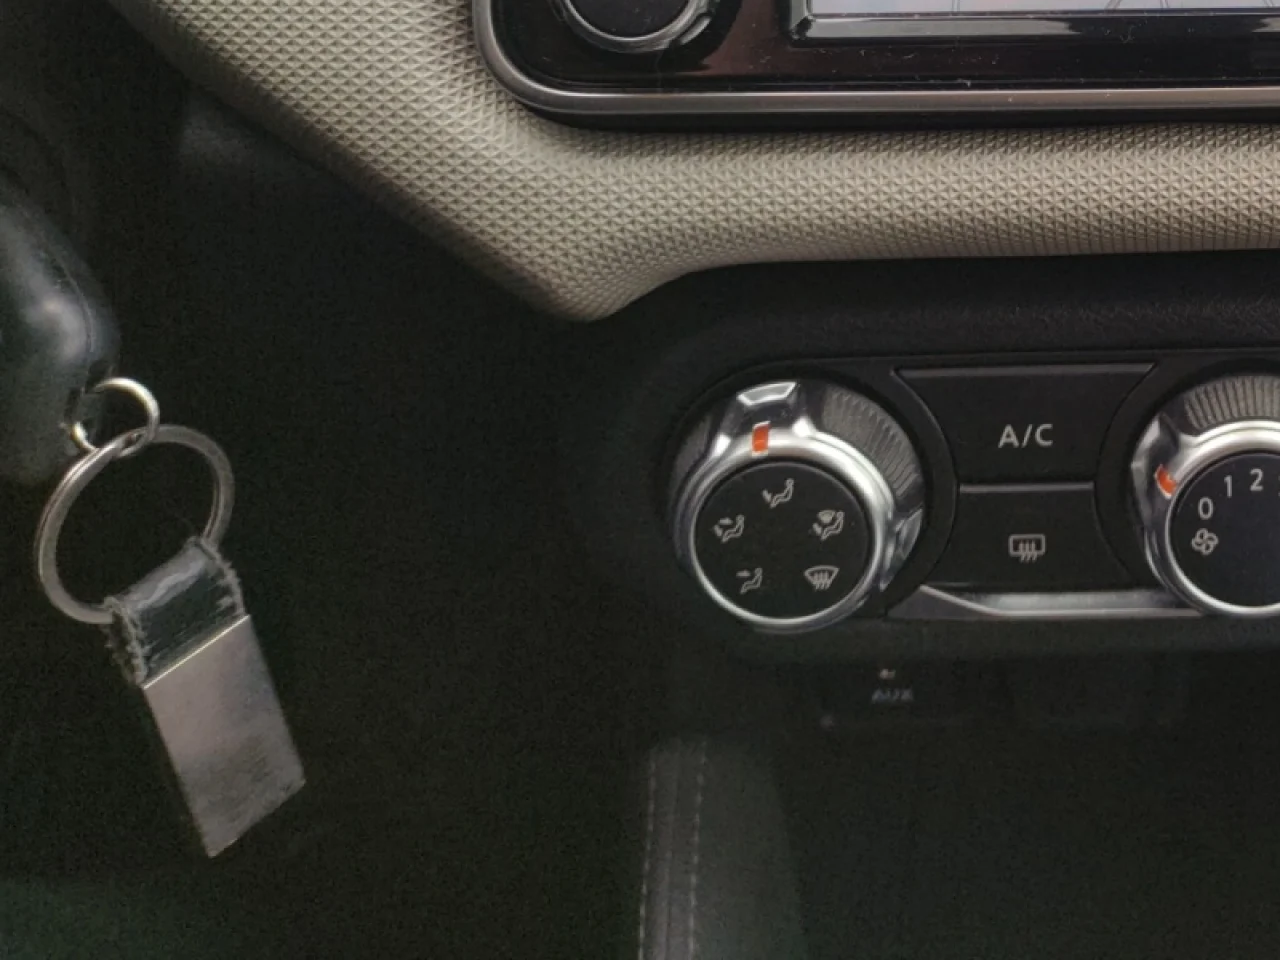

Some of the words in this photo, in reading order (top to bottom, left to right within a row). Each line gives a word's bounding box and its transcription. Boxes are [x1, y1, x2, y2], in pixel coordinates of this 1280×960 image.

[999, 424, 1053, 450] A/C
[1199, 497, 1213, 520] 0
[1223, 475, 1233, 497] 1
[1249, 468, 1264, 490] 2
